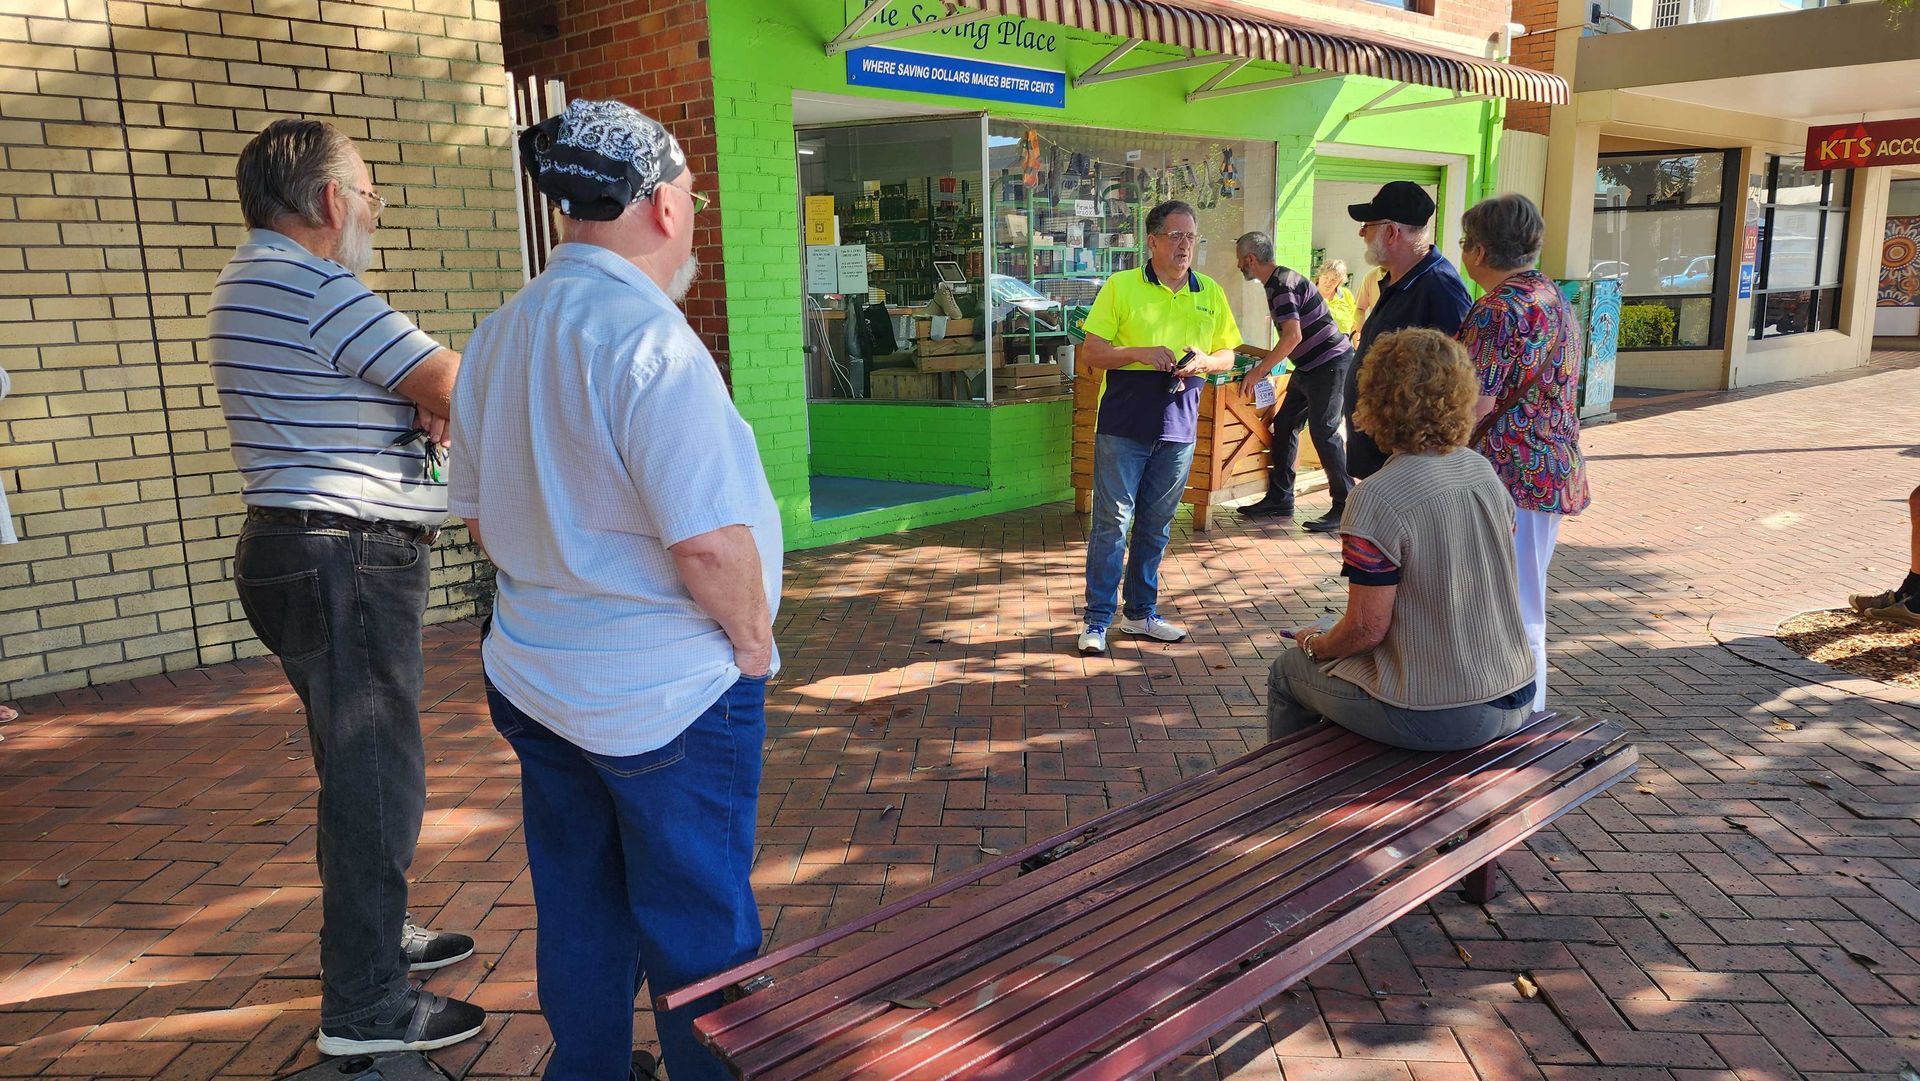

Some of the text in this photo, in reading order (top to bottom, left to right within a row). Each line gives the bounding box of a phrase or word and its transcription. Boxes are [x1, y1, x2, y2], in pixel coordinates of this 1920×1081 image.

[864, 0, 899, 26] he
[998, 19, 1057, 52] Place
[862, 58, 1055, 94] WHERE SAVING DOLLARS MAKES BETTER CENTS
[1821, 137, 1872, 161] KTS
